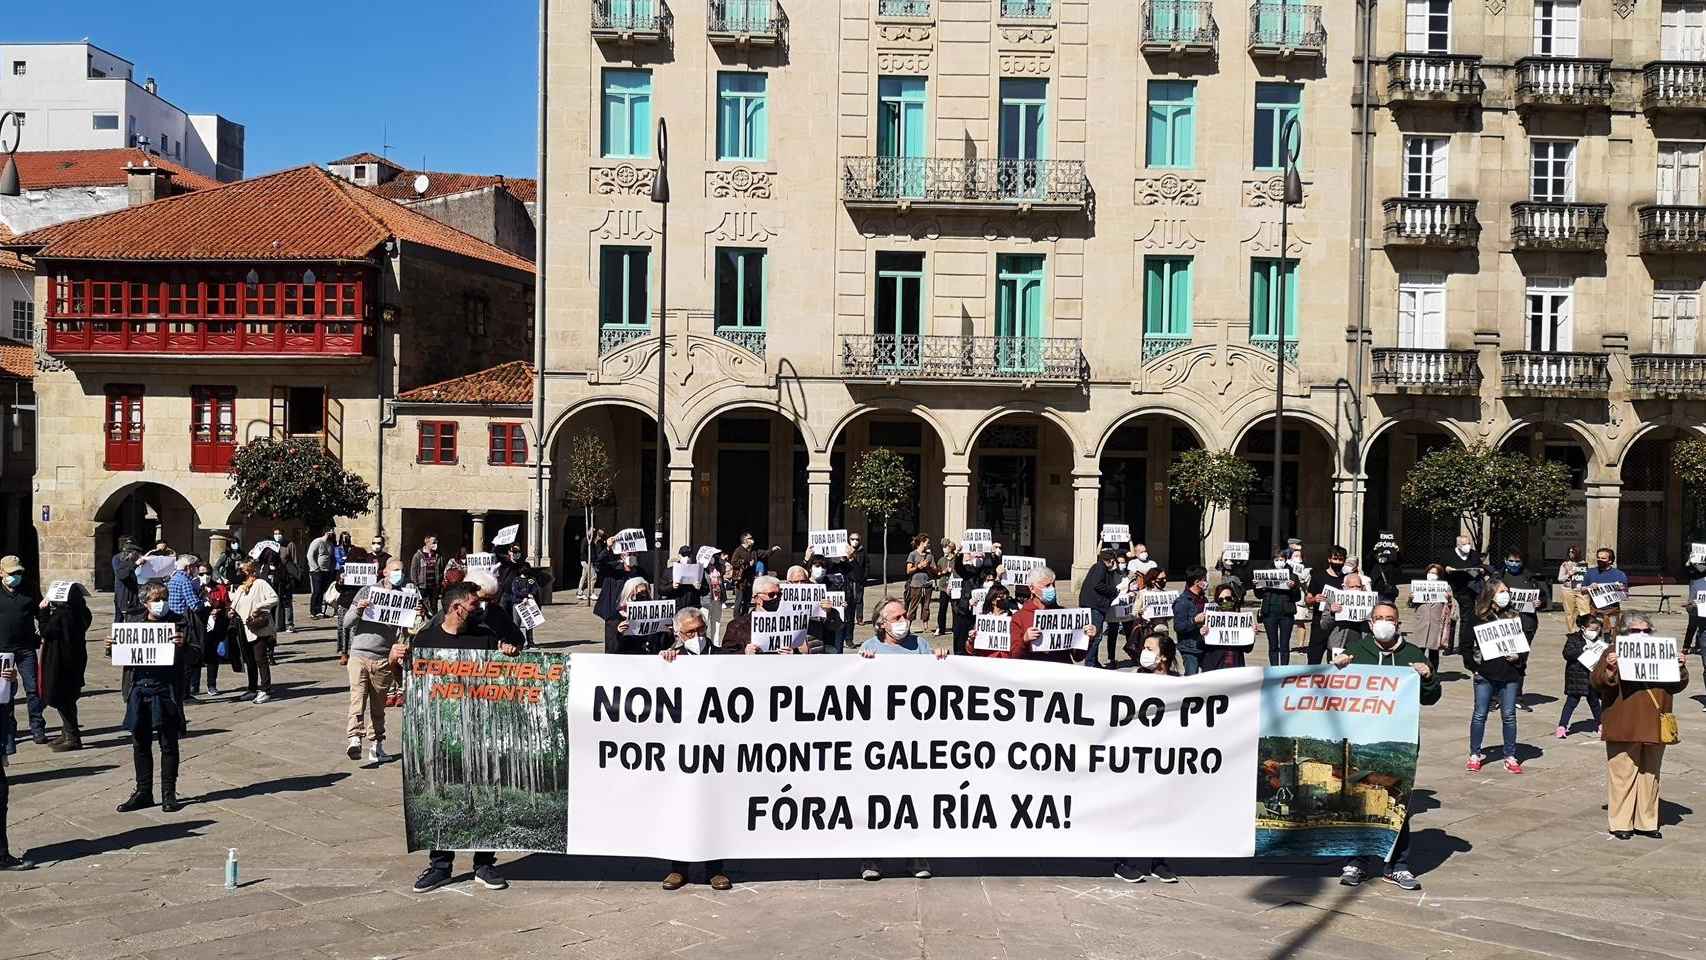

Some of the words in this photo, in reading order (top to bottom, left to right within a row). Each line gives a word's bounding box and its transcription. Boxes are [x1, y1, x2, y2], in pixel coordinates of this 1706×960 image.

[1003, 559, 1021, 571] FORA
[1022, 560, 1031, 571] DA
[1014, 573, 1023, 584] XA
[370, 590, 390, 608] FORA
[391, 594, 403, 609] DA
[801, 588, 811, 602] DA
[1337, 593, 1355, 606] FORA
[1356, 593, 1366, 607] DA
[379, 608, 391, 623] XA
[391, 610, 401, 624] !!!
[628, 605, 647, 620] FORA
[649, 604, 659, 619] DA
[661, 601, 674, 619] RÍA
[1349, 608, 1357, 620] XA
[1359, 608, 1367, 620] !!!
[639, 622, 650, 634] XA
[650, 621, 660, 633] !!!
[753, 616, 777, 633] FORA
[779, 616, 791, 632] DA
[793, 611, 808, 631] RÍA
[977, 618, 996, 633] FORA
[997, 619, 1007, 633] DA
[1036, 614, 1058, 631] FORA
[1060, 613, 1073, 630] DA
[1207, 615, 1226, 628] FORA
[1228, 615, 1239, 628] DA
[113, 628, 139, 644] FORA
[141, 628, 155, 644] DA
[1219, 631, 1230, 644] XA
[1231, 631, 1240, 644] !!!
[1477, 625, 1499, 642] FORA
[1499, 622, 1512, 637] DA
[768, 635, 781, 651] XA
[988, 635, 998, 649] XA
[1000, 636, 1008, 650] !!!
[1049, 633, 1060, 650] XA
[1063, 633, 1073, 648] !!!
[1496, 640, 1508, 653] XA
[1618, 641, 1641, 658] FORA
[1644, 642, 1656, 659] DA
[1660, 639, 1675, 659] RÍA
[131, 647, 143, 664] XA
[146, 647, 157, 664] !!!
[413, 658, 564, 681] COMBUSTIBLE
[1635, 663, 1646, 680] XA
[1649, 663, 1659, 680] !!!
[1281, 674, 1363, 689] PERIGO
[1366, 675, 1400, 692] EN
[431, 683, 465, 701] NO
[468, 683, 543, 704] MONTE
[592, 685, 683, 723] NON
[698, 686, 754, 724] AO
[769, 684, 872, 722] PLAN
[886, 684, 1095, 727] FORESTAL
[1109, 694, 1166, 728] DO
[1180, 694, 1230, 728] PP
[1284, 695, 1396, 715] LOURIZÁN
[599, 740, 666, 772] POR
[678, 744, 725, 774] UN
[737, 741, 853, 773] MONTE
[864, 740, 995, 771] GALEGO
[1007, 742, 1076, 772] CON
[1088, 744, 1223, 775] FUTURO
[747, 783, 853, 831] FÓRA
[867, 794, 919, 831] DA
[932, 780, 997, 830] RÍA
[1010, 794, 1072, 830] XA!
